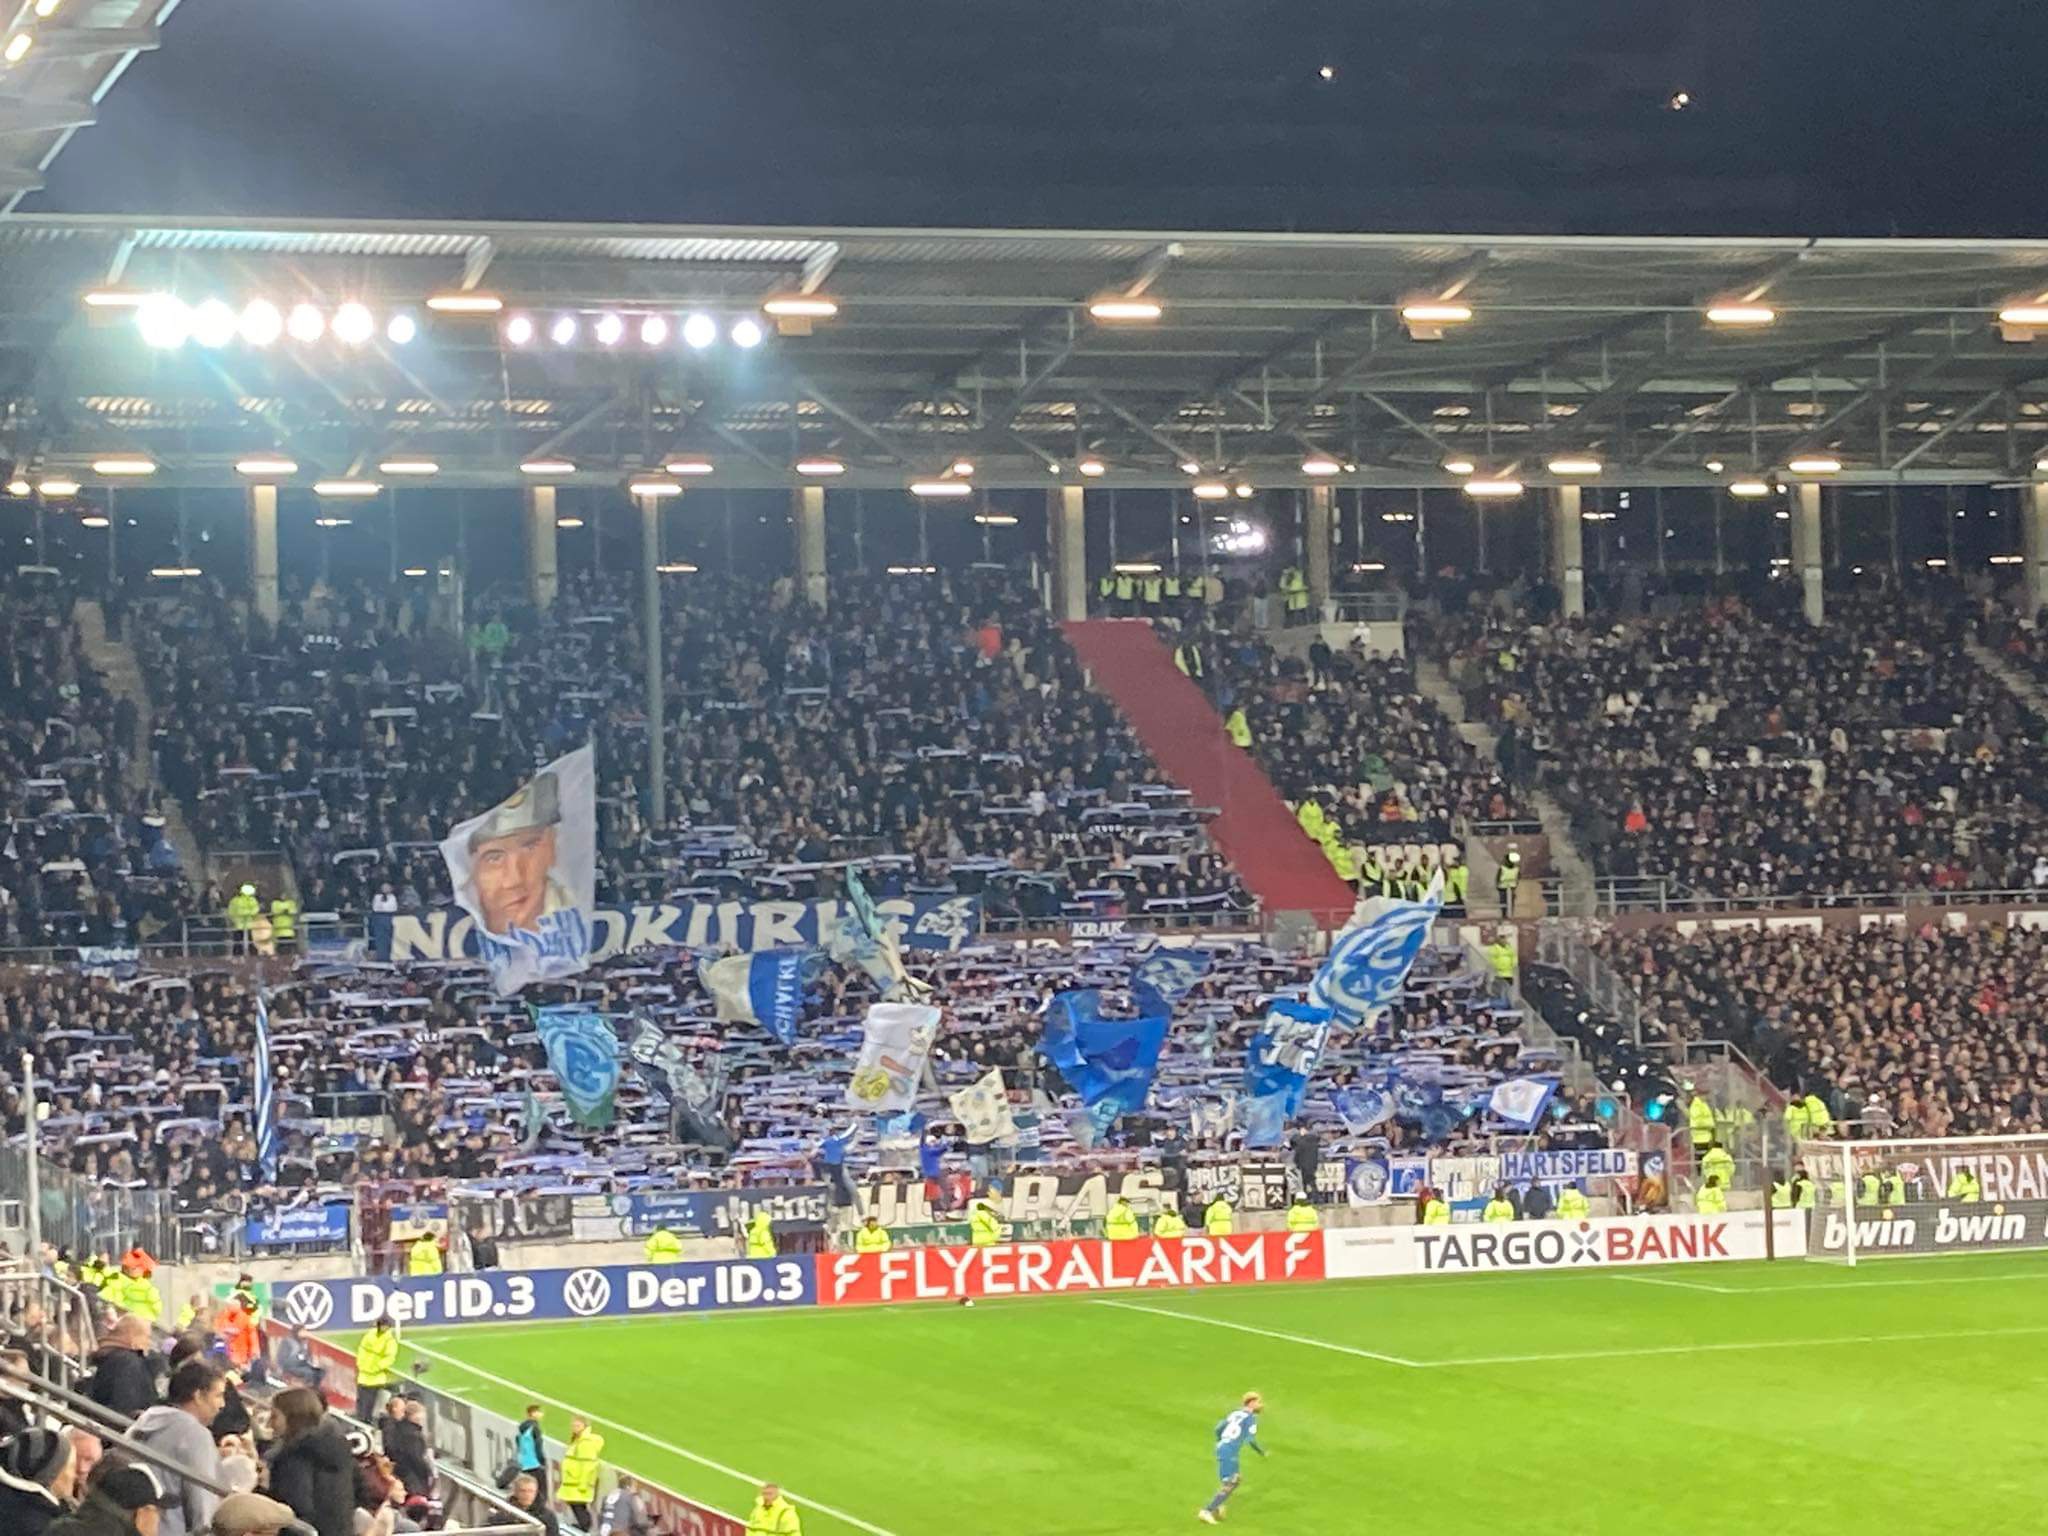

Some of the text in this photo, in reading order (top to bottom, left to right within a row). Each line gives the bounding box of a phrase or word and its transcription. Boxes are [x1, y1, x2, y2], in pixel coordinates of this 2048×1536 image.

[390, 898, 915, 963] NODKURE
[1503, 1151, 1626, 1178] HARTSFELD
[850, 1172, 1167, 1226] ULRAS
[1414, 1223, 1729, 1270] TARGO BANK
[1823, 1209, 1916, 1249] bwin
[1935, 1204, 2026, 1243] bwin
[626, 1270, 706, 1309] Der
[714, 1262, 803, 1304] ID.3
[879, 1235, 1266, 1300] FLYERALARM
[351, 1283, 434, 1323] Der
[443, 1275, 536, 1317] ID.3
